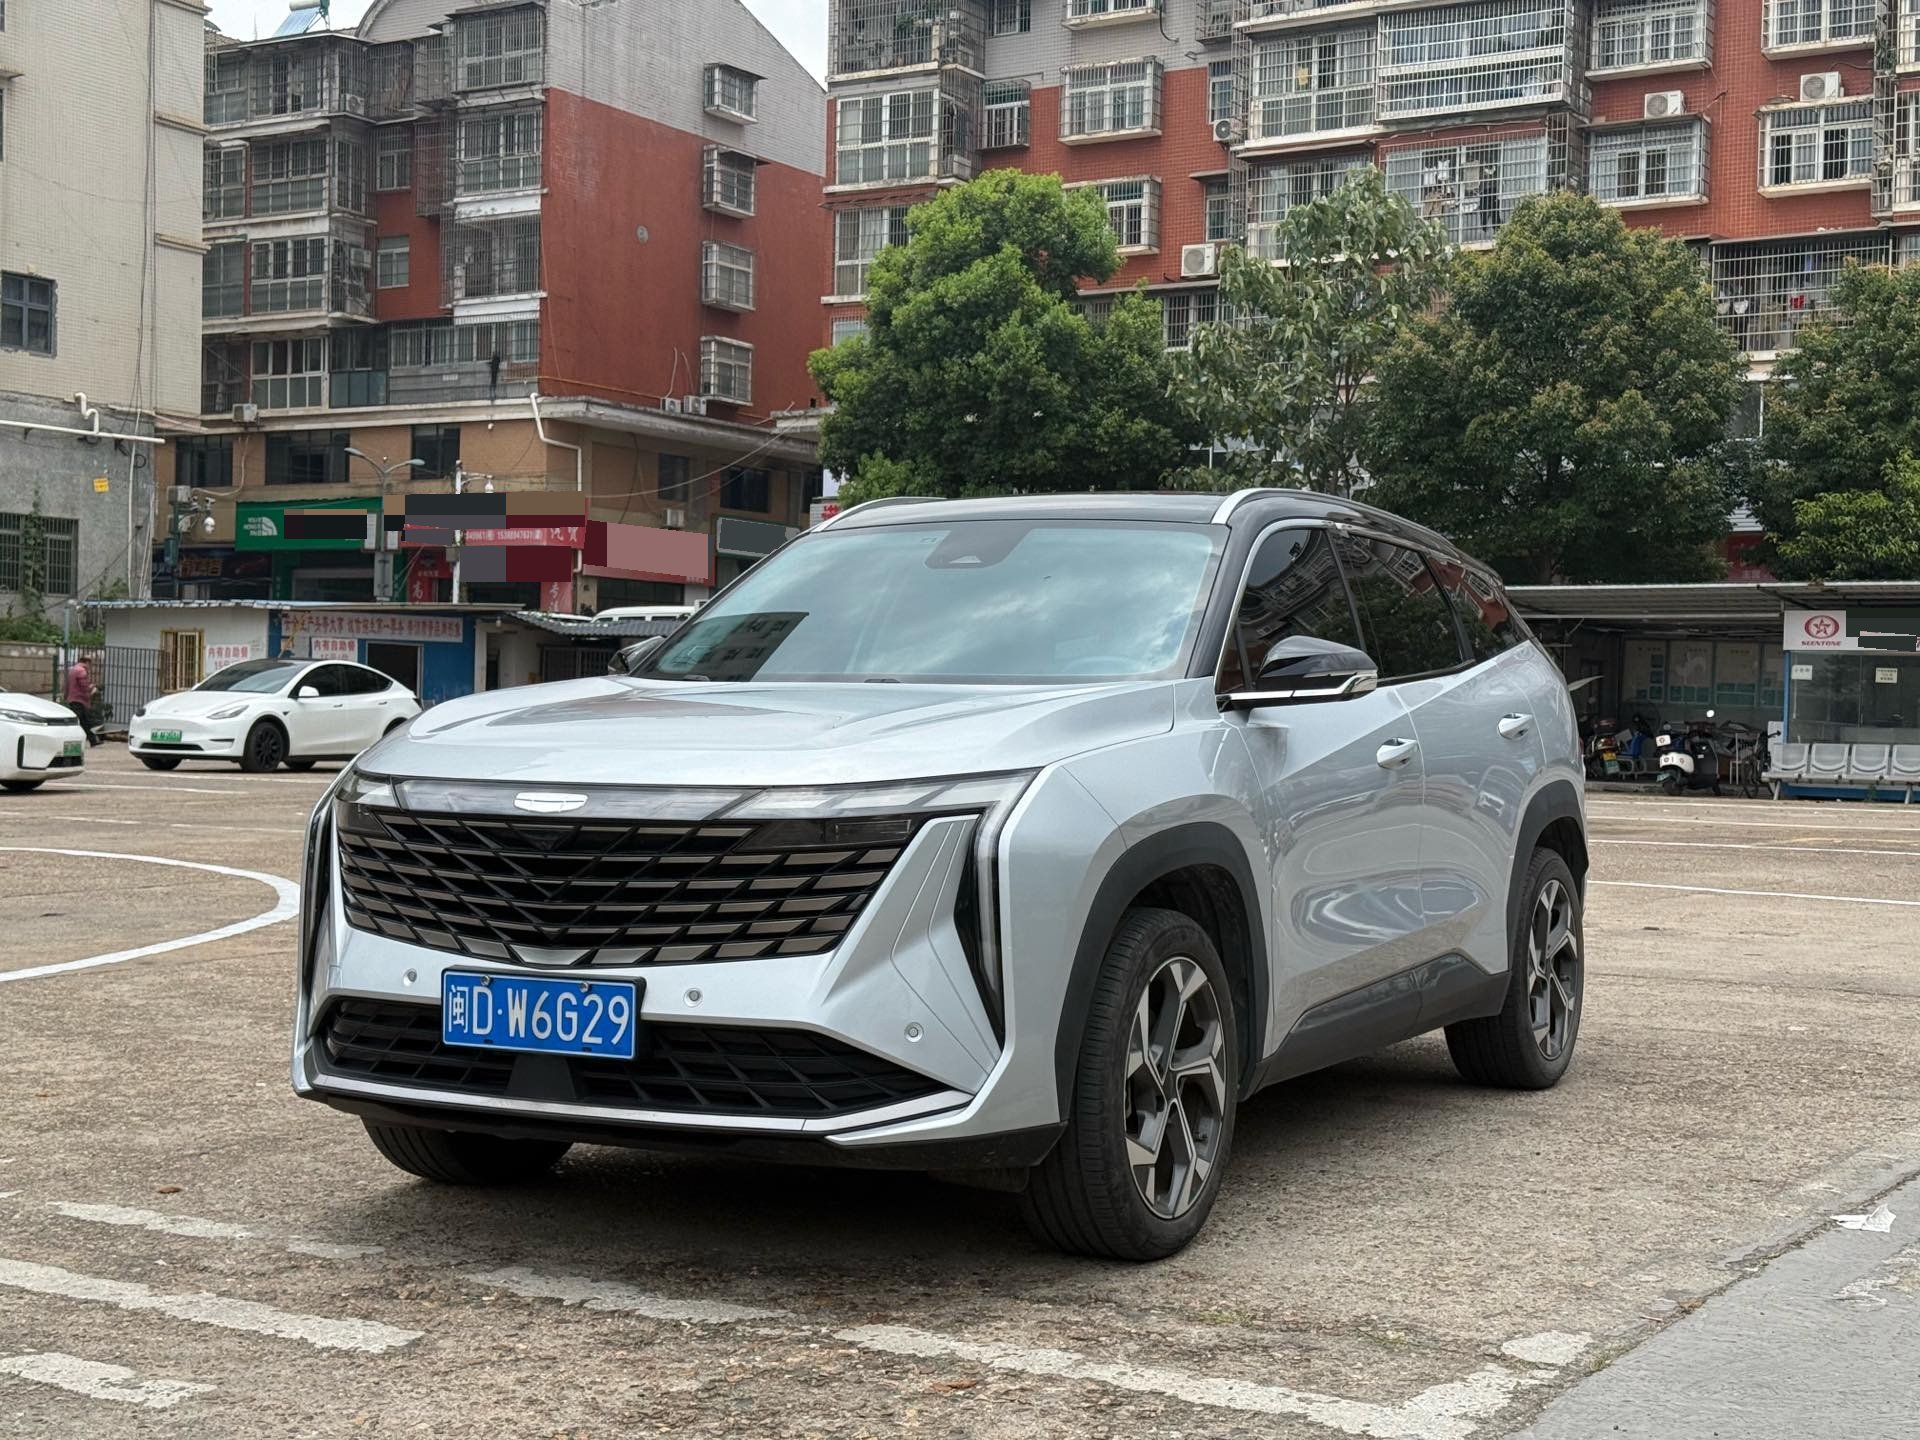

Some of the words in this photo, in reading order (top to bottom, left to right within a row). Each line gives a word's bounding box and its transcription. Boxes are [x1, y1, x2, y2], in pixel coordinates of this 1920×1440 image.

[313, 639, 356, 652] 内有自助餐
[208, 646, 248, 658] 内有自助餐
